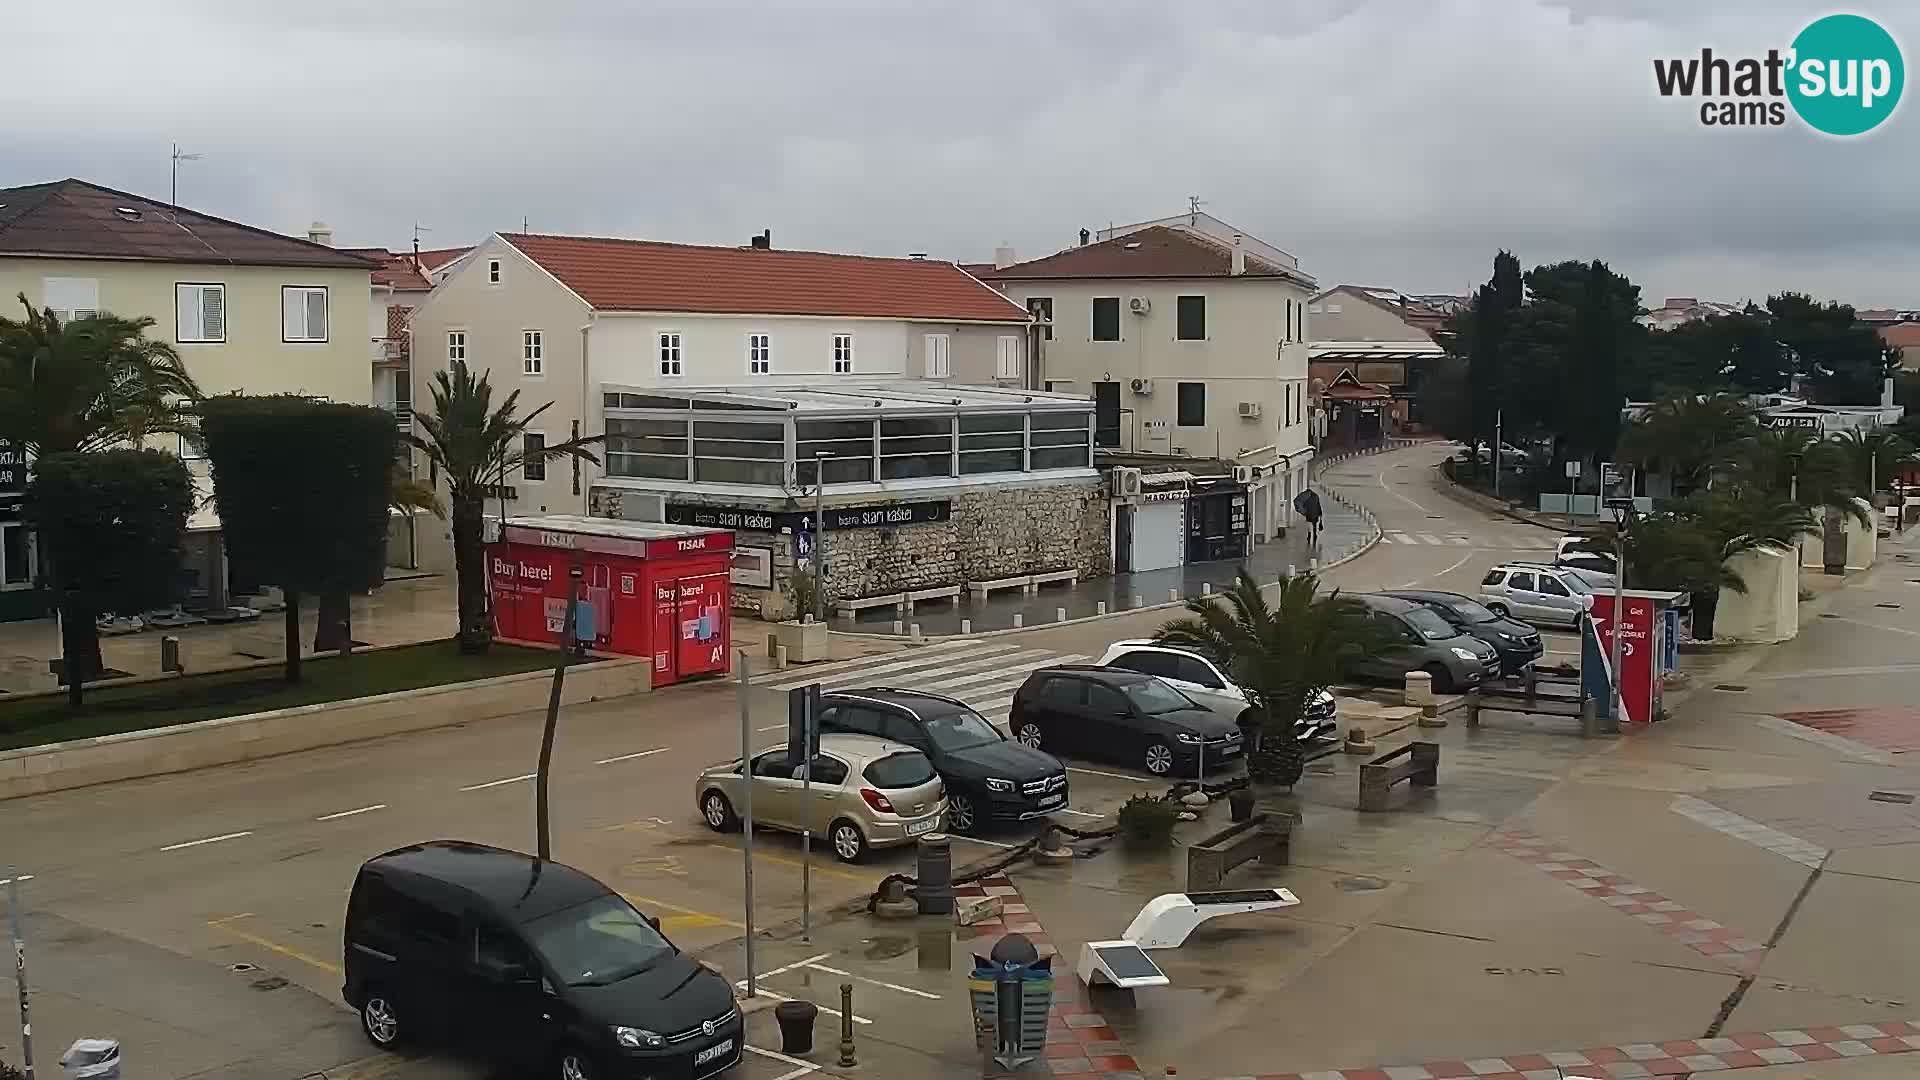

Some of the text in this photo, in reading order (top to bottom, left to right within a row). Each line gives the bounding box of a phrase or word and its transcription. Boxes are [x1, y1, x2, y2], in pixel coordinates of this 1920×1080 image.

[677, 538, 706, 551] TISAK
[494, 557, 552, 581] Buy here!
[658, 583, 704, 601] Buy here!
[711, 644, 723, 663] A1
